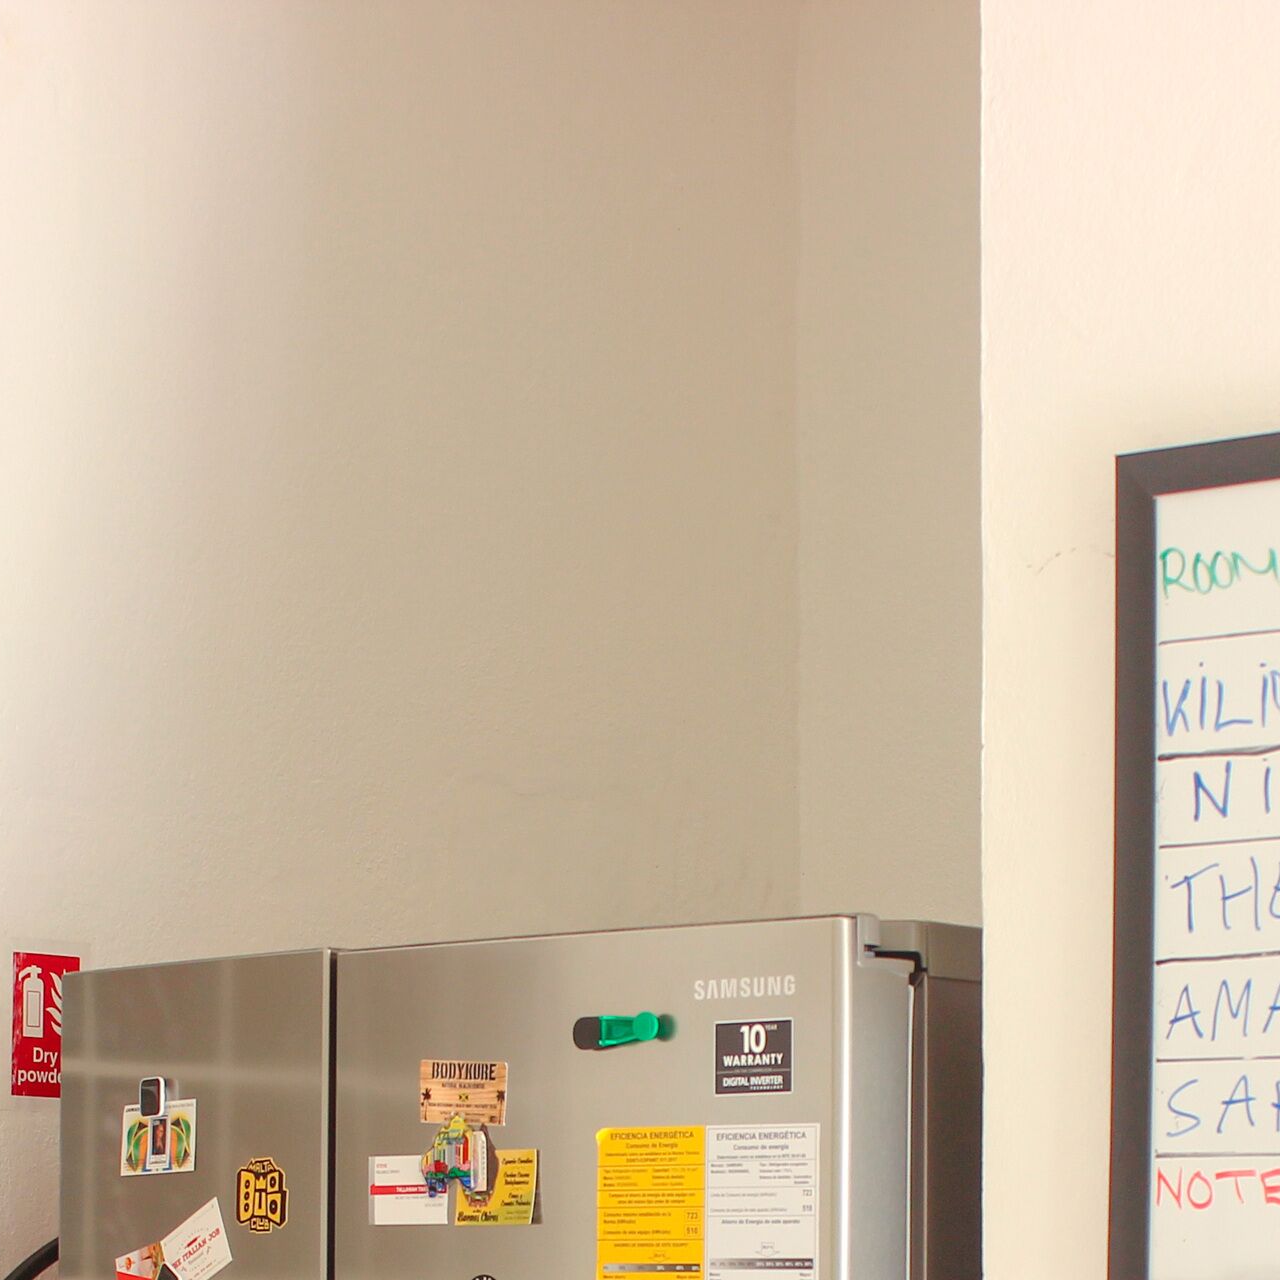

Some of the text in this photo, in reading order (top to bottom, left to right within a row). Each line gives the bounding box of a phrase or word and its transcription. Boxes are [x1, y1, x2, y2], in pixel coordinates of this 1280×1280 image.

[693, 975, 797, 1001] SAMSUNG
[739, 1023, 767, 1054] 10
[32, 1046, 59, 1068] Dry
[723, 1053, 783, 1067] WARRANTY
[17, 1068, 62, 1086] powd
[722, 1075, 784, 1088] DIGITAL INVERTER
[610, 1132, 647, 1140] EFICIENCIA
[716, 1131, 807, 1141] EFICIENCIA ENERGÉTICA
[247, 1159, 276, 1171] MALTA
[250, 1218, 270, 1231] CLUB
[182, 1240, 207, 1262] ITALIAN
[208, 1228, 221, 1241] JOB
